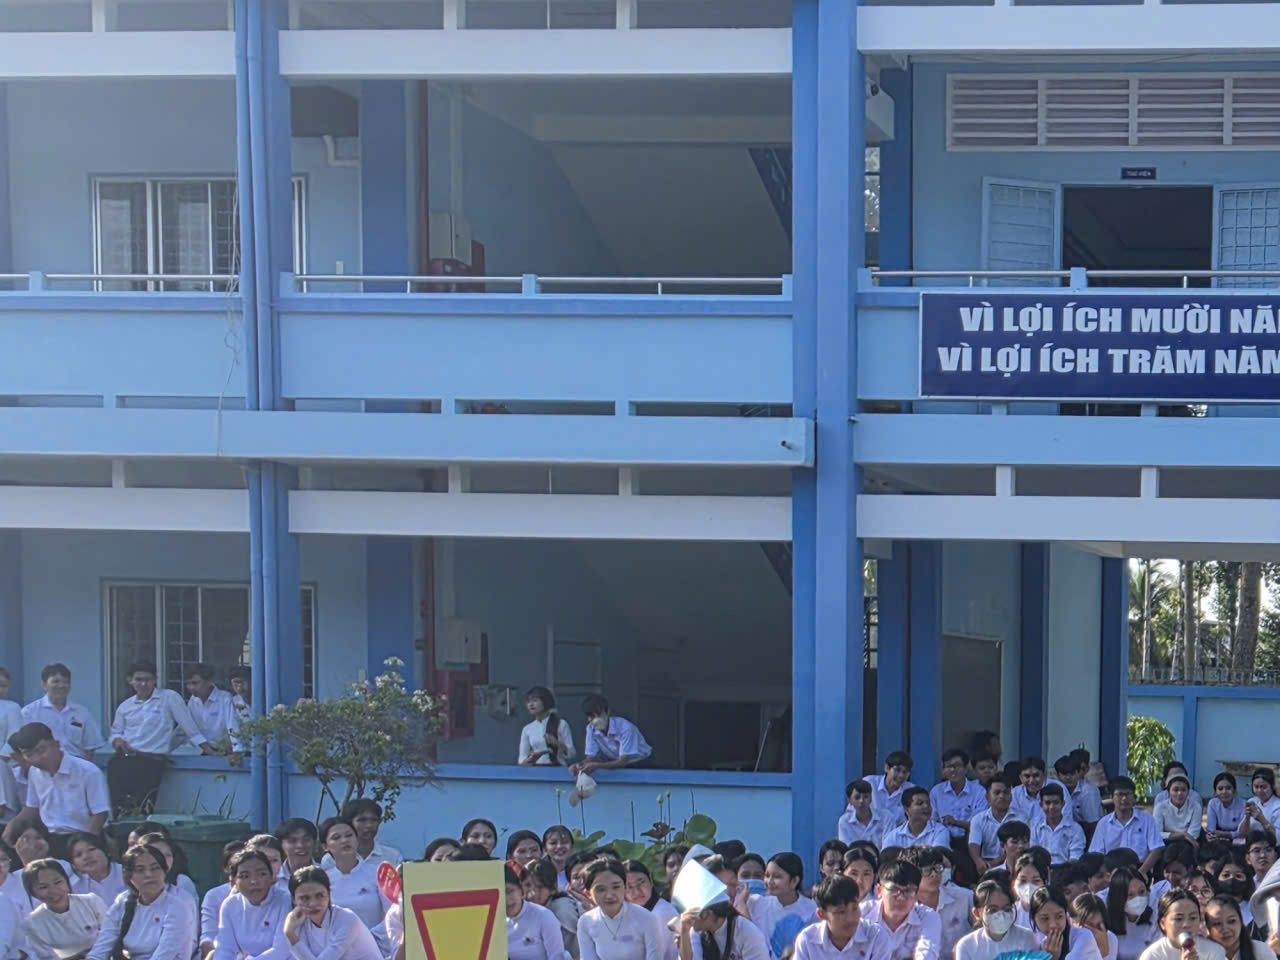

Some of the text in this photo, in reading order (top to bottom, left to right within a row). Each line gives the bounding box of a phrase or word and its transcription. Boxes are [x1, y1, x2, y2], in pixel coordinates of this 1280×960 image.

[959, 301, 994, 332] VÌ
[1003, 302, 1053, 337] LỢI
[1062, 302, 1122, 333] ÍCH
[1131, 303, 1221, 334] MƯỜI
[937, 342, 973, 372] VÌ
[980, 344, 1032, 378] LỢI
[1039, 342, 1099, 373] ÍCH
[1107, 345, 1206, 374] TRĂM
